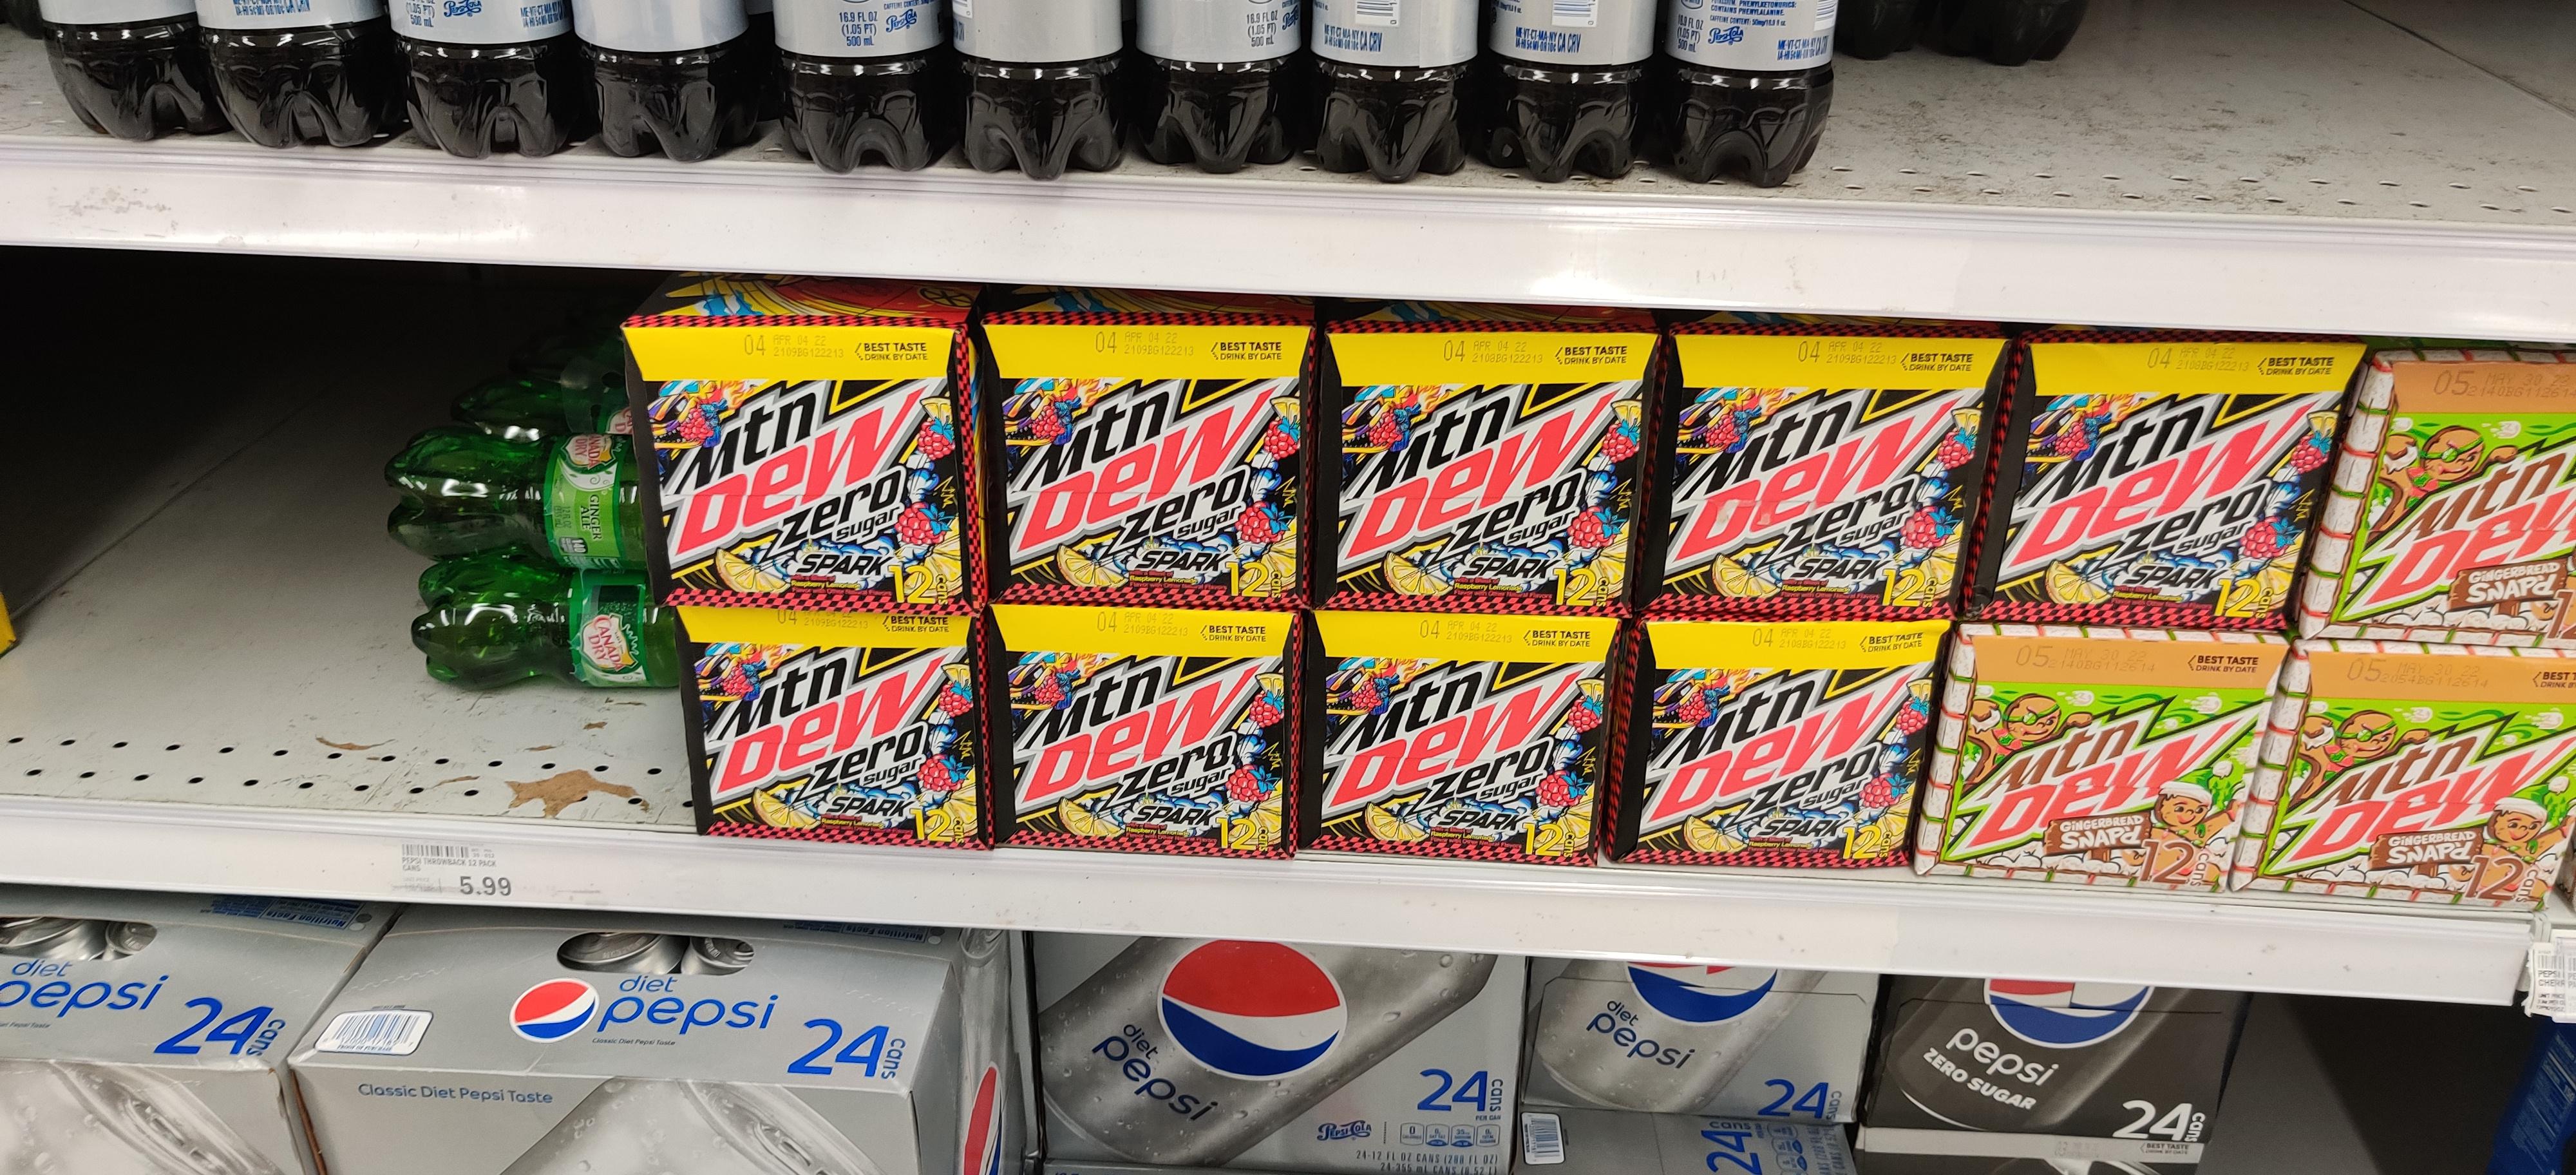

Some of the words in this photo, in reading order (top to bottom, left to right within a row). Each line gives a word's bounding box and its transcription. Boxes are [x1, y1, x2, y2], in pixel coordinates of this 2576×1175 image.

[744, 334, 766, 356] 04
[864, 342, 890, 352] BEST
[893, 342, 927, 352] TASTE
[1220, 341, 1246, 351] BEST
[1250, 341, 1282, 351] TASTE
[1565, 346, 1592, 356] BEST
[1594, 346, 1628, 355] TASTE
[1911, 353, 1937, 362] BEST
[1940, 353, 1975, 363] TASTE
[2268, 357, 2297, 367] BEST
[2299, 357, 2335, 367] TASTE
[580, 505, 592, 531] ALE
[590, 495, 603, 540] GINGER
[772, 470, 904, 552] zero
[1116, 470, 1243, 546] zero
[1177, 508, 1240, 540] sugar
[1444, 473, 1578, 551] zero
[1773, 479, 1916, 553] zero
[2113, 483, 2267, 558] zero
[837, 508, 901, 542] sugar
[1508, 512, 1573, 546] sugar
[1839, 512, 1904, 545] sugar
[2177, 519, 2248, 553] sugar
[796, 553, 893, 577] SPARK
[1137, 551, 1231, 572] SPARK
[1463, 556, 1558, 579] SPARK
[1794, 559, 1888, 580] SPARK
[2132, 565, 2230, 590] SPARK
[2468, 562, 2561, 583] GINGERBREAD
[889, 565, 936, 604] 12
[935, 573, 949, 606] cans
[1225, 562, 1270, 597] 12
[1555, 568, 1597, 606] 12
[1596, 577, 1608, 607] cans
[1882, 569, 1927, 607] 12
[2213, 578, 2262, 618] 12
[891, 616, 916, 624] BEST
[918, 616, 949, 625] TASTE
[1209, 626, 1234, 634] BEST
[1236, 626, 1266, 635] TASTE
[1532, 630, 1557, 638] BEST
[1560, 631, 1590, 639] TASTE
[589, 634, 609, 660] DRY
[593, 615, 625, 671] CANADA
[1869, 635, 1895, 644] BEST
[1896, 632, 1923, 642] TASTE
[2197, 656, 2223, 664] BEST
[2227, 656, 2259, 665] TASTE
[2543, 671, 2568, 680] BEST
[804, 725, 922, 791] zero
[863, 758, 921, 786] sugar
[1112, 736, 1233, 800] zero
[1421, 741, 1547, 806] zero
[1171, 768, 1230, 796] sugar
[1481, 773, 1540, 802] sugar
[1739, 745, 1877, 819] zero
[1804, 778, 1866, 810] sugar
[829, 796, 914, 816] SPARK
[1133, 805, 1222, 826] SPARK
[1439, 810, 1528, 831] SPARK
[911, 807, 953, 842] 12
[1215, 817, 1257, 850] 12
[1523, 823, 1565, 857] 12
[1759, 818, 1850, 839] SPARK
[2060, 816, 2144, 832] GINGERBREAD
[2387, 831, 2477, 846] GINGERBREAD
[1563, 832, 1574, 857] cans
[1841, 826, 1882, 859] 12
[2140, 839, 2194, 884] 12
[2190, 852, 2210, 887] cans
[2465, 856, 2525, 900] 12
[460, 876, 511, 897] 5.99
[2516, 868, 2539, 904] cans
[12, 959, 73, 978] diet
[620, 975, 678, 993] diet
[153, 997, 274, 1055] 24
[597, 994, 779, 1035] pepsi
[1606, 1000, 1639, 1027] diet
[246, 1018, 287, 1057] cans
[787, 1018, 889, 1078] 24
[1123, 1024, 1159, 1060] diet
[1586, 1013, 1696, 1069] pepsi
[882, 1038, 907, 1079] cans
[1945, 1027, 2060, 1087] pepsi
[358, 1083, 416, 1098] Classic
[421, 1085, 456, 1099] Diet
[460, 1087, 504, 1103] Pepsi
[507, 1089, 553, 1104] Taste
[1092, 1035, 1219, 1122] pepsi
[1417, 1069, 1488, 1112] 24
[1490, 1078, 1503, 1112] cans
[1922, 1047, 1969, 1085] ZERO
[1967, 1076, 2037, 1111] SUGAR
[1757, 1078, 1829, 1120] 24
[1826, 1091, 1842, 1122] cans
[2112, 1100, 2193, 1142] 24
[2184, 1112, 2206, 1142] cans
